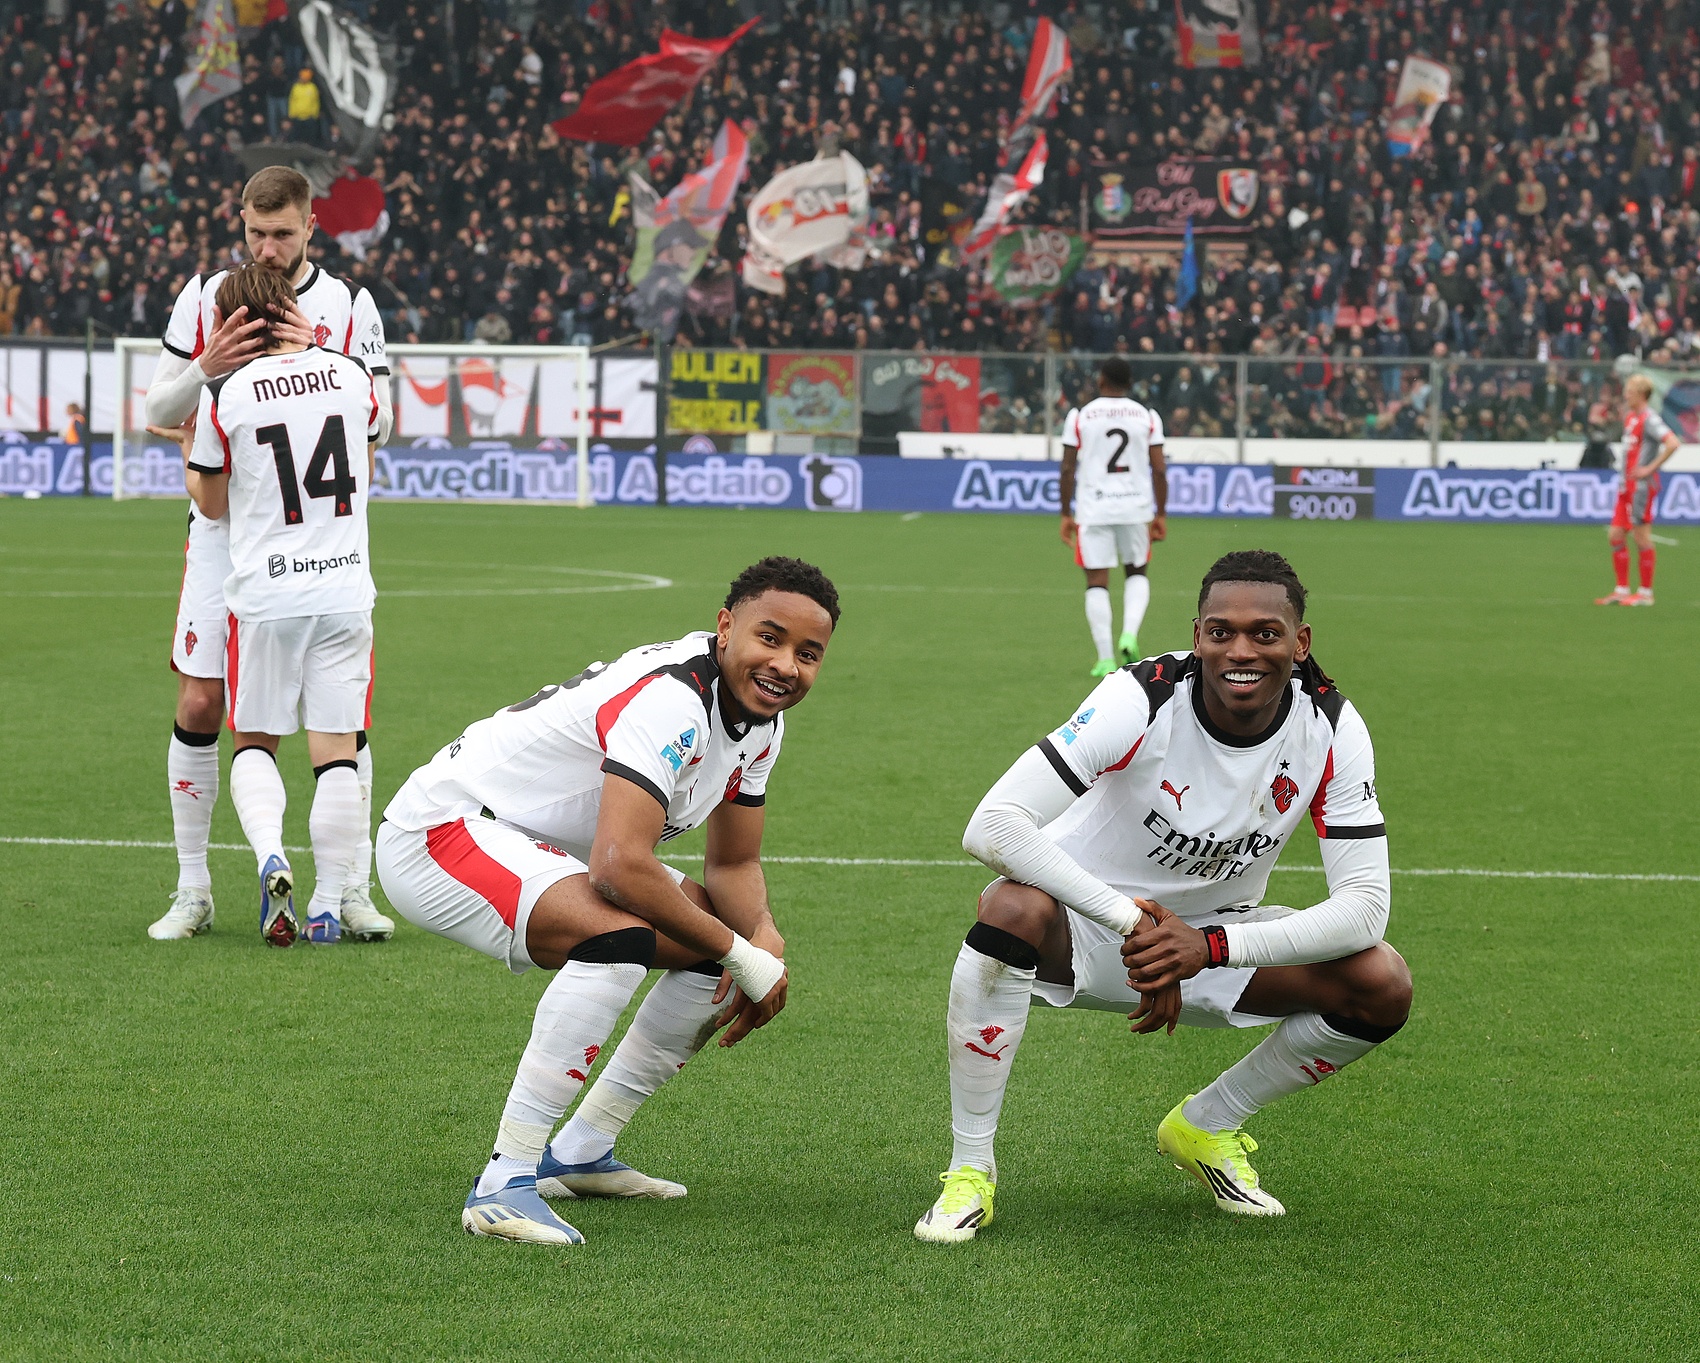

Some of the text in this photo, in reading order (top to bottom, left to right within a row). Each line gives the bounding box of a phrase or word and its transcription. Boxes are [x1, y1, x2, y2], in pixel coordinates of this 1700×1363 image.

[253, 364, 341, 402] MODRIĆ
[1106, 428, 1129, 473] 2
[63, 452, 182, 489] Accia
[256, 415, 356, 525] 14
[960, 466, 1061, 503] Arve
[1289, 495, 1357, 520] 90:00
[1410, 476, 1615, 512] Arvedi Tu
[1143, 808, 1284, 859] Emirates
[1147, 845, 1189, 871] FLY
